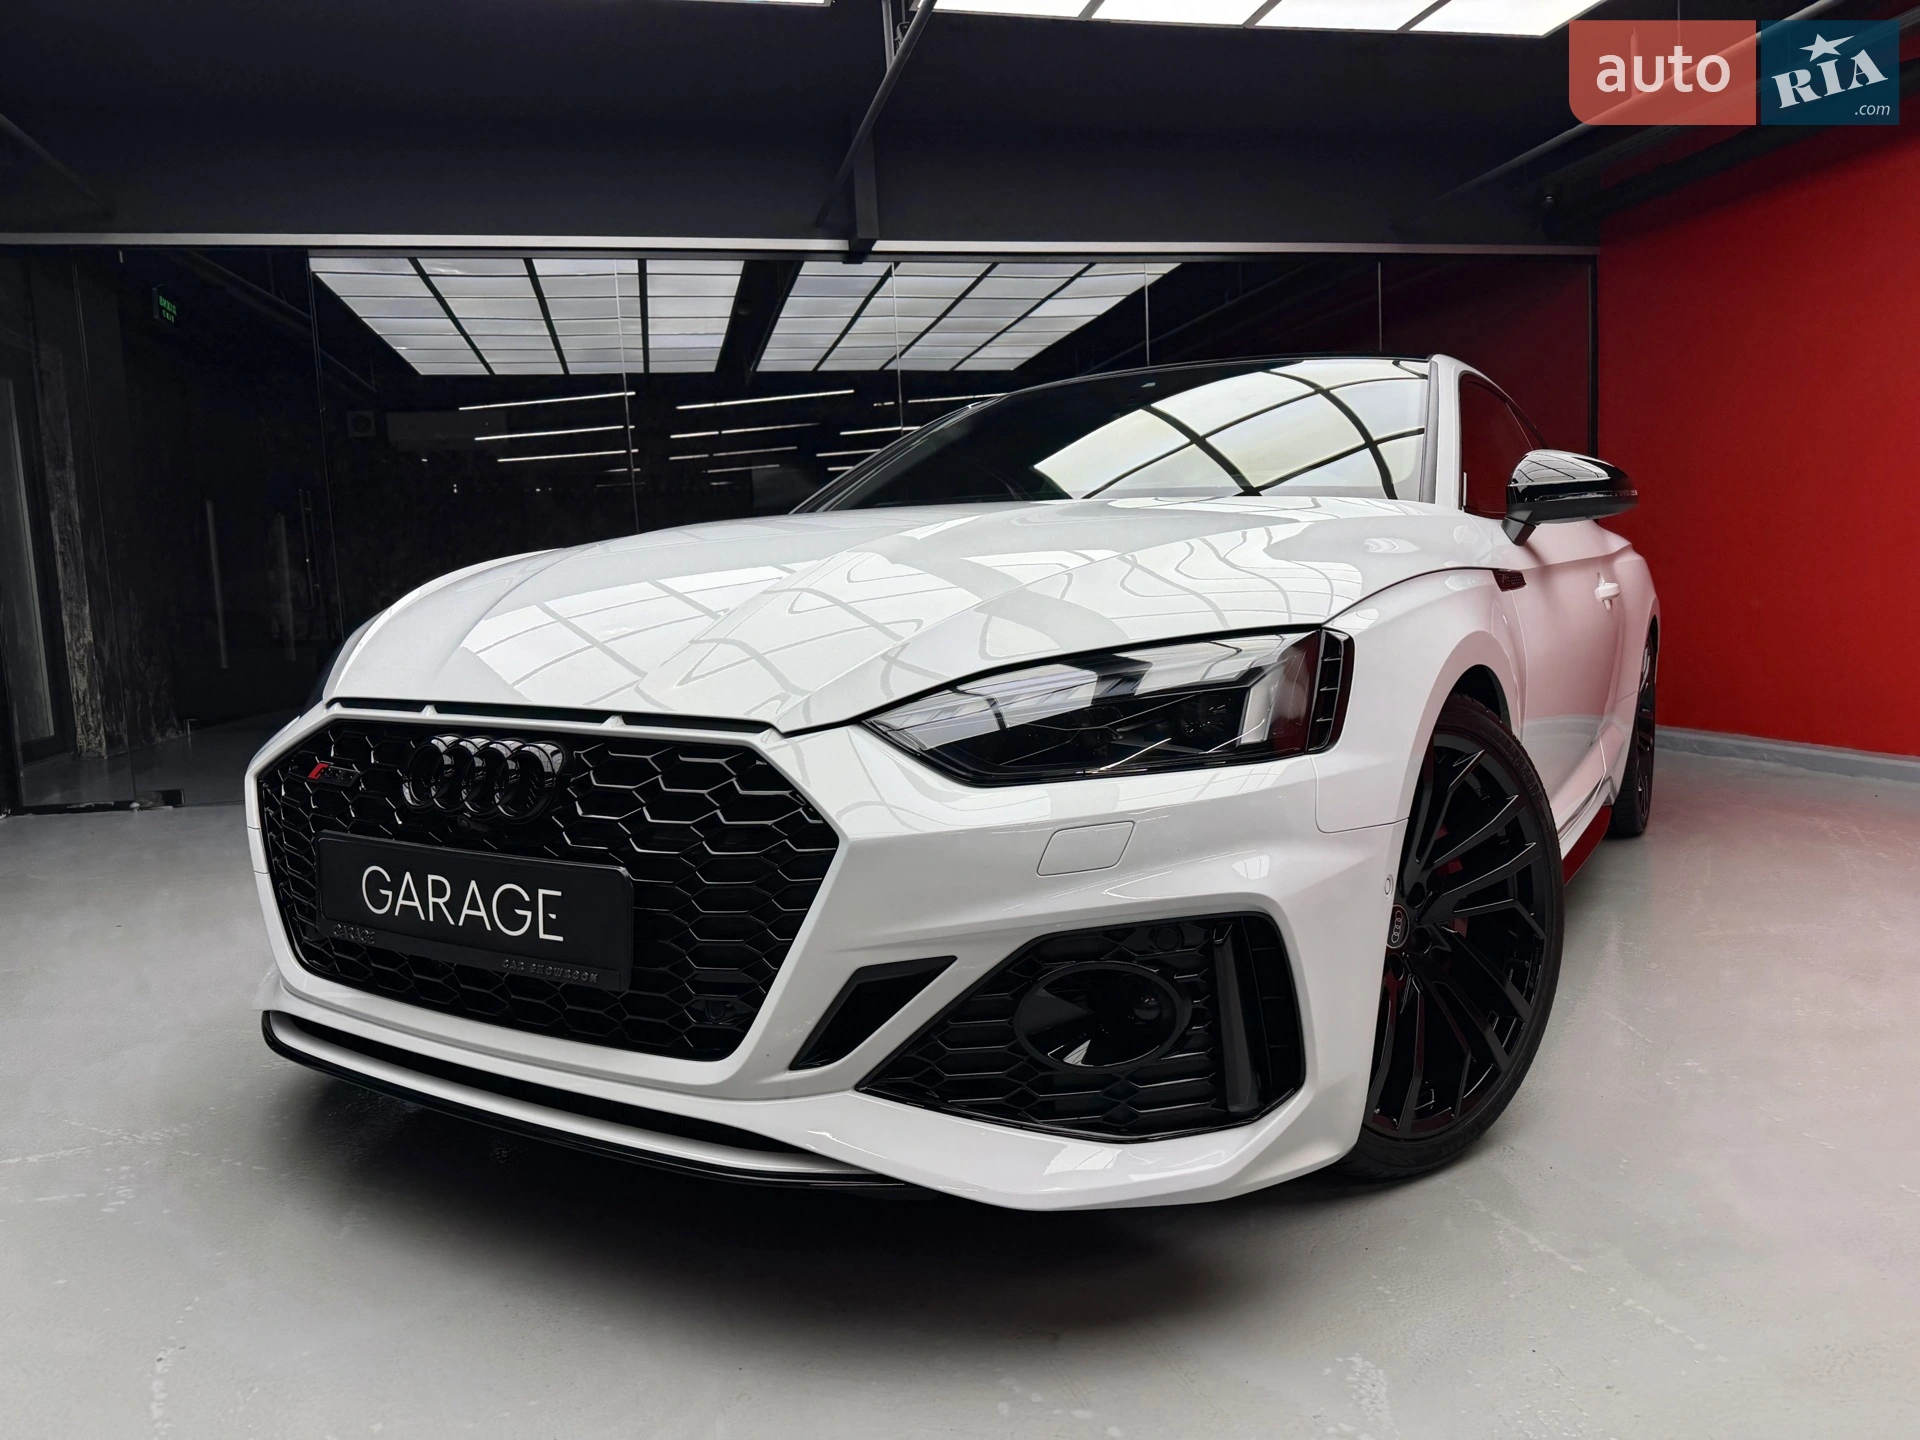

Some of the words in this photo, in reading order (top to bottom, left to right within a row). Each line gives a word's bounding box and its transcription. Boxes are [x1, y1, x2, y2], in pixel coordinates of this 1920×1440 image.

[361, 865, 564, 942] GARAGE
[333, 923, 376, 945] GARAGE
[530, 963, 598, 983] SHOWROOM
